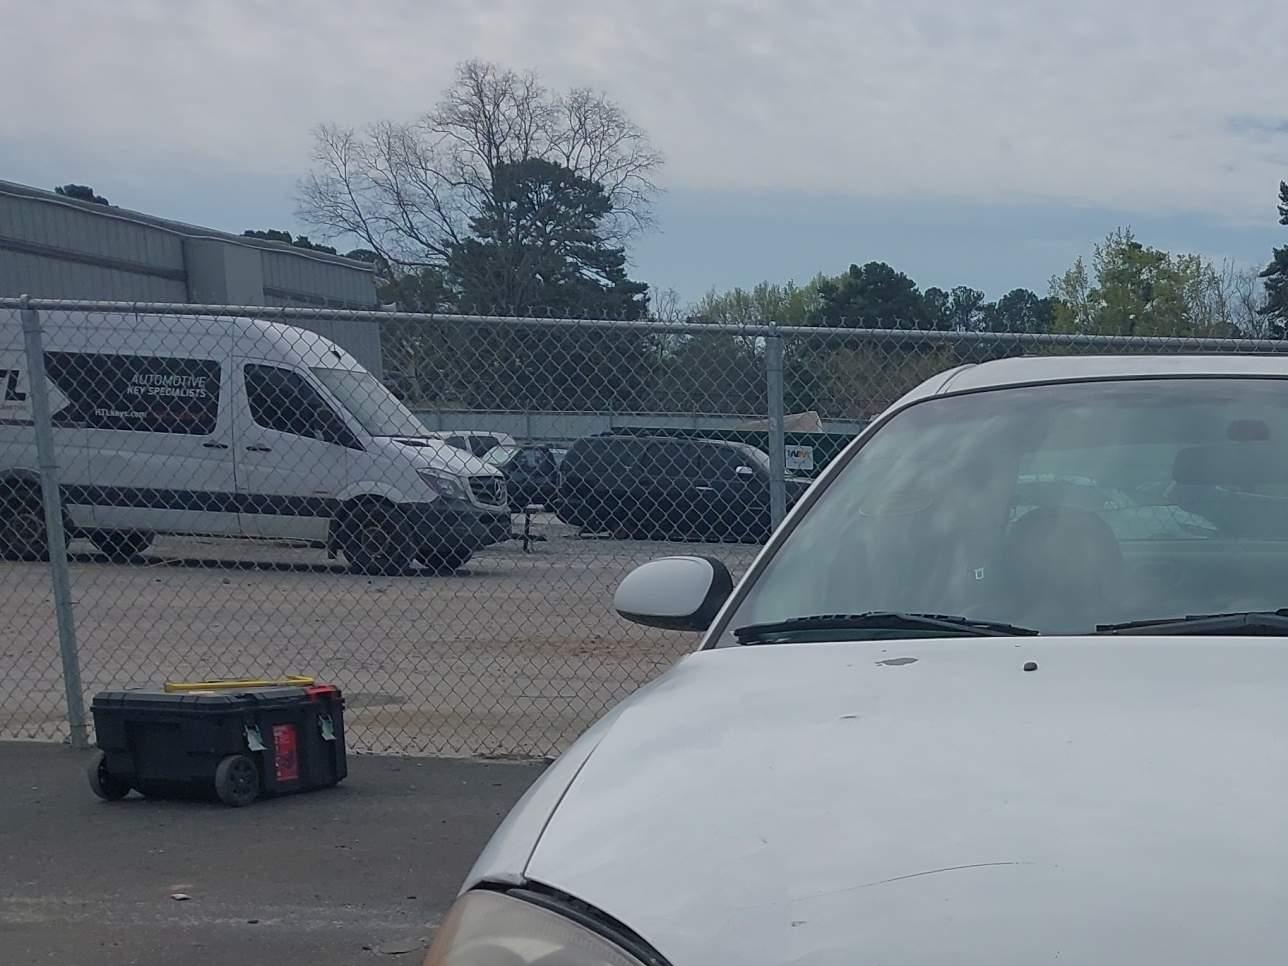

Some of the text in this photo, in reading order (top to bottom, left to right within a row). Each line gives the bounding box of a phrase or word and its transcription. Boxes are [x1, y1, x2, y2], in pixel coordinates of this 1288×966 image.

[131, 374, 207, 388] AUTOMOTIVE
[127, 386, 207, 398] KEY SPECIALISTS
